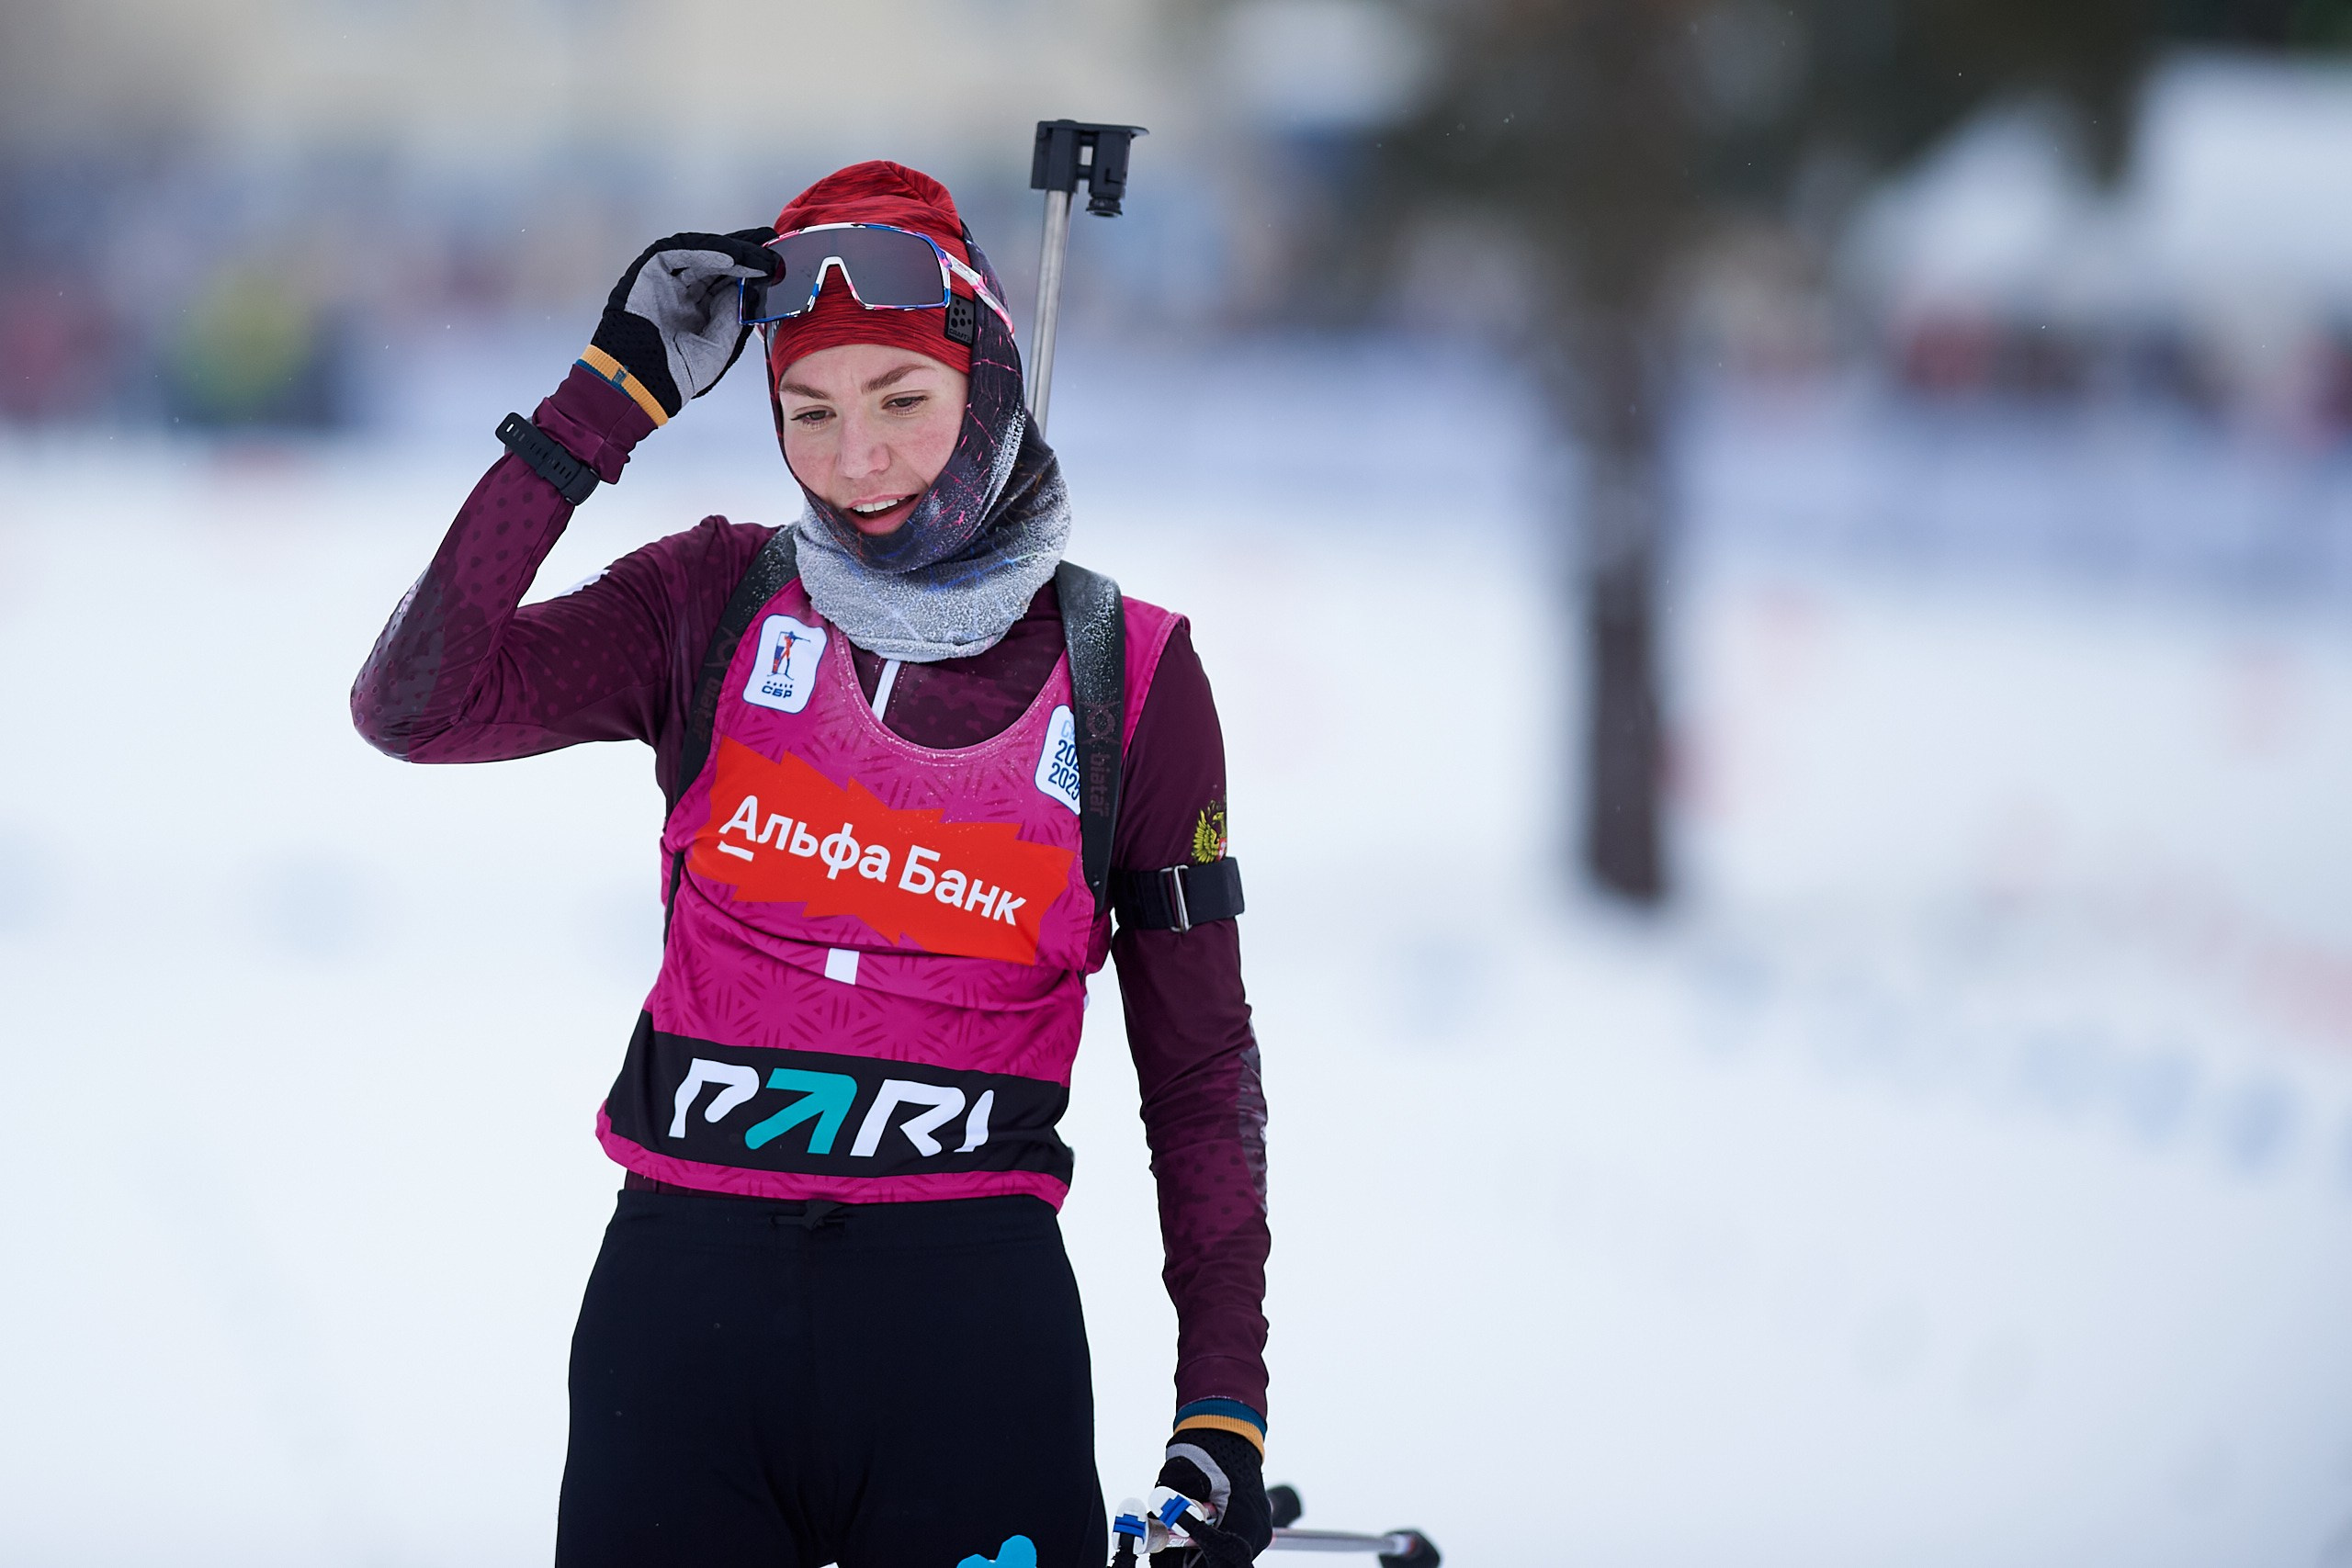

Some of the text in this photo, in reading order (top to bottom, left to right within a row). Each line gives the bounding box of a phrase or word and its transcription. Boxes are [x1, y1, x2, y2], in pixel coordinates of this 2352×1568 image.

[761, 684, 793, 698] СБР
[1047, 761, 1080, 801] 2025
[717, 794, 1027, 927] Альфа Банк
[668, 1057, 995, 1157] PARI
